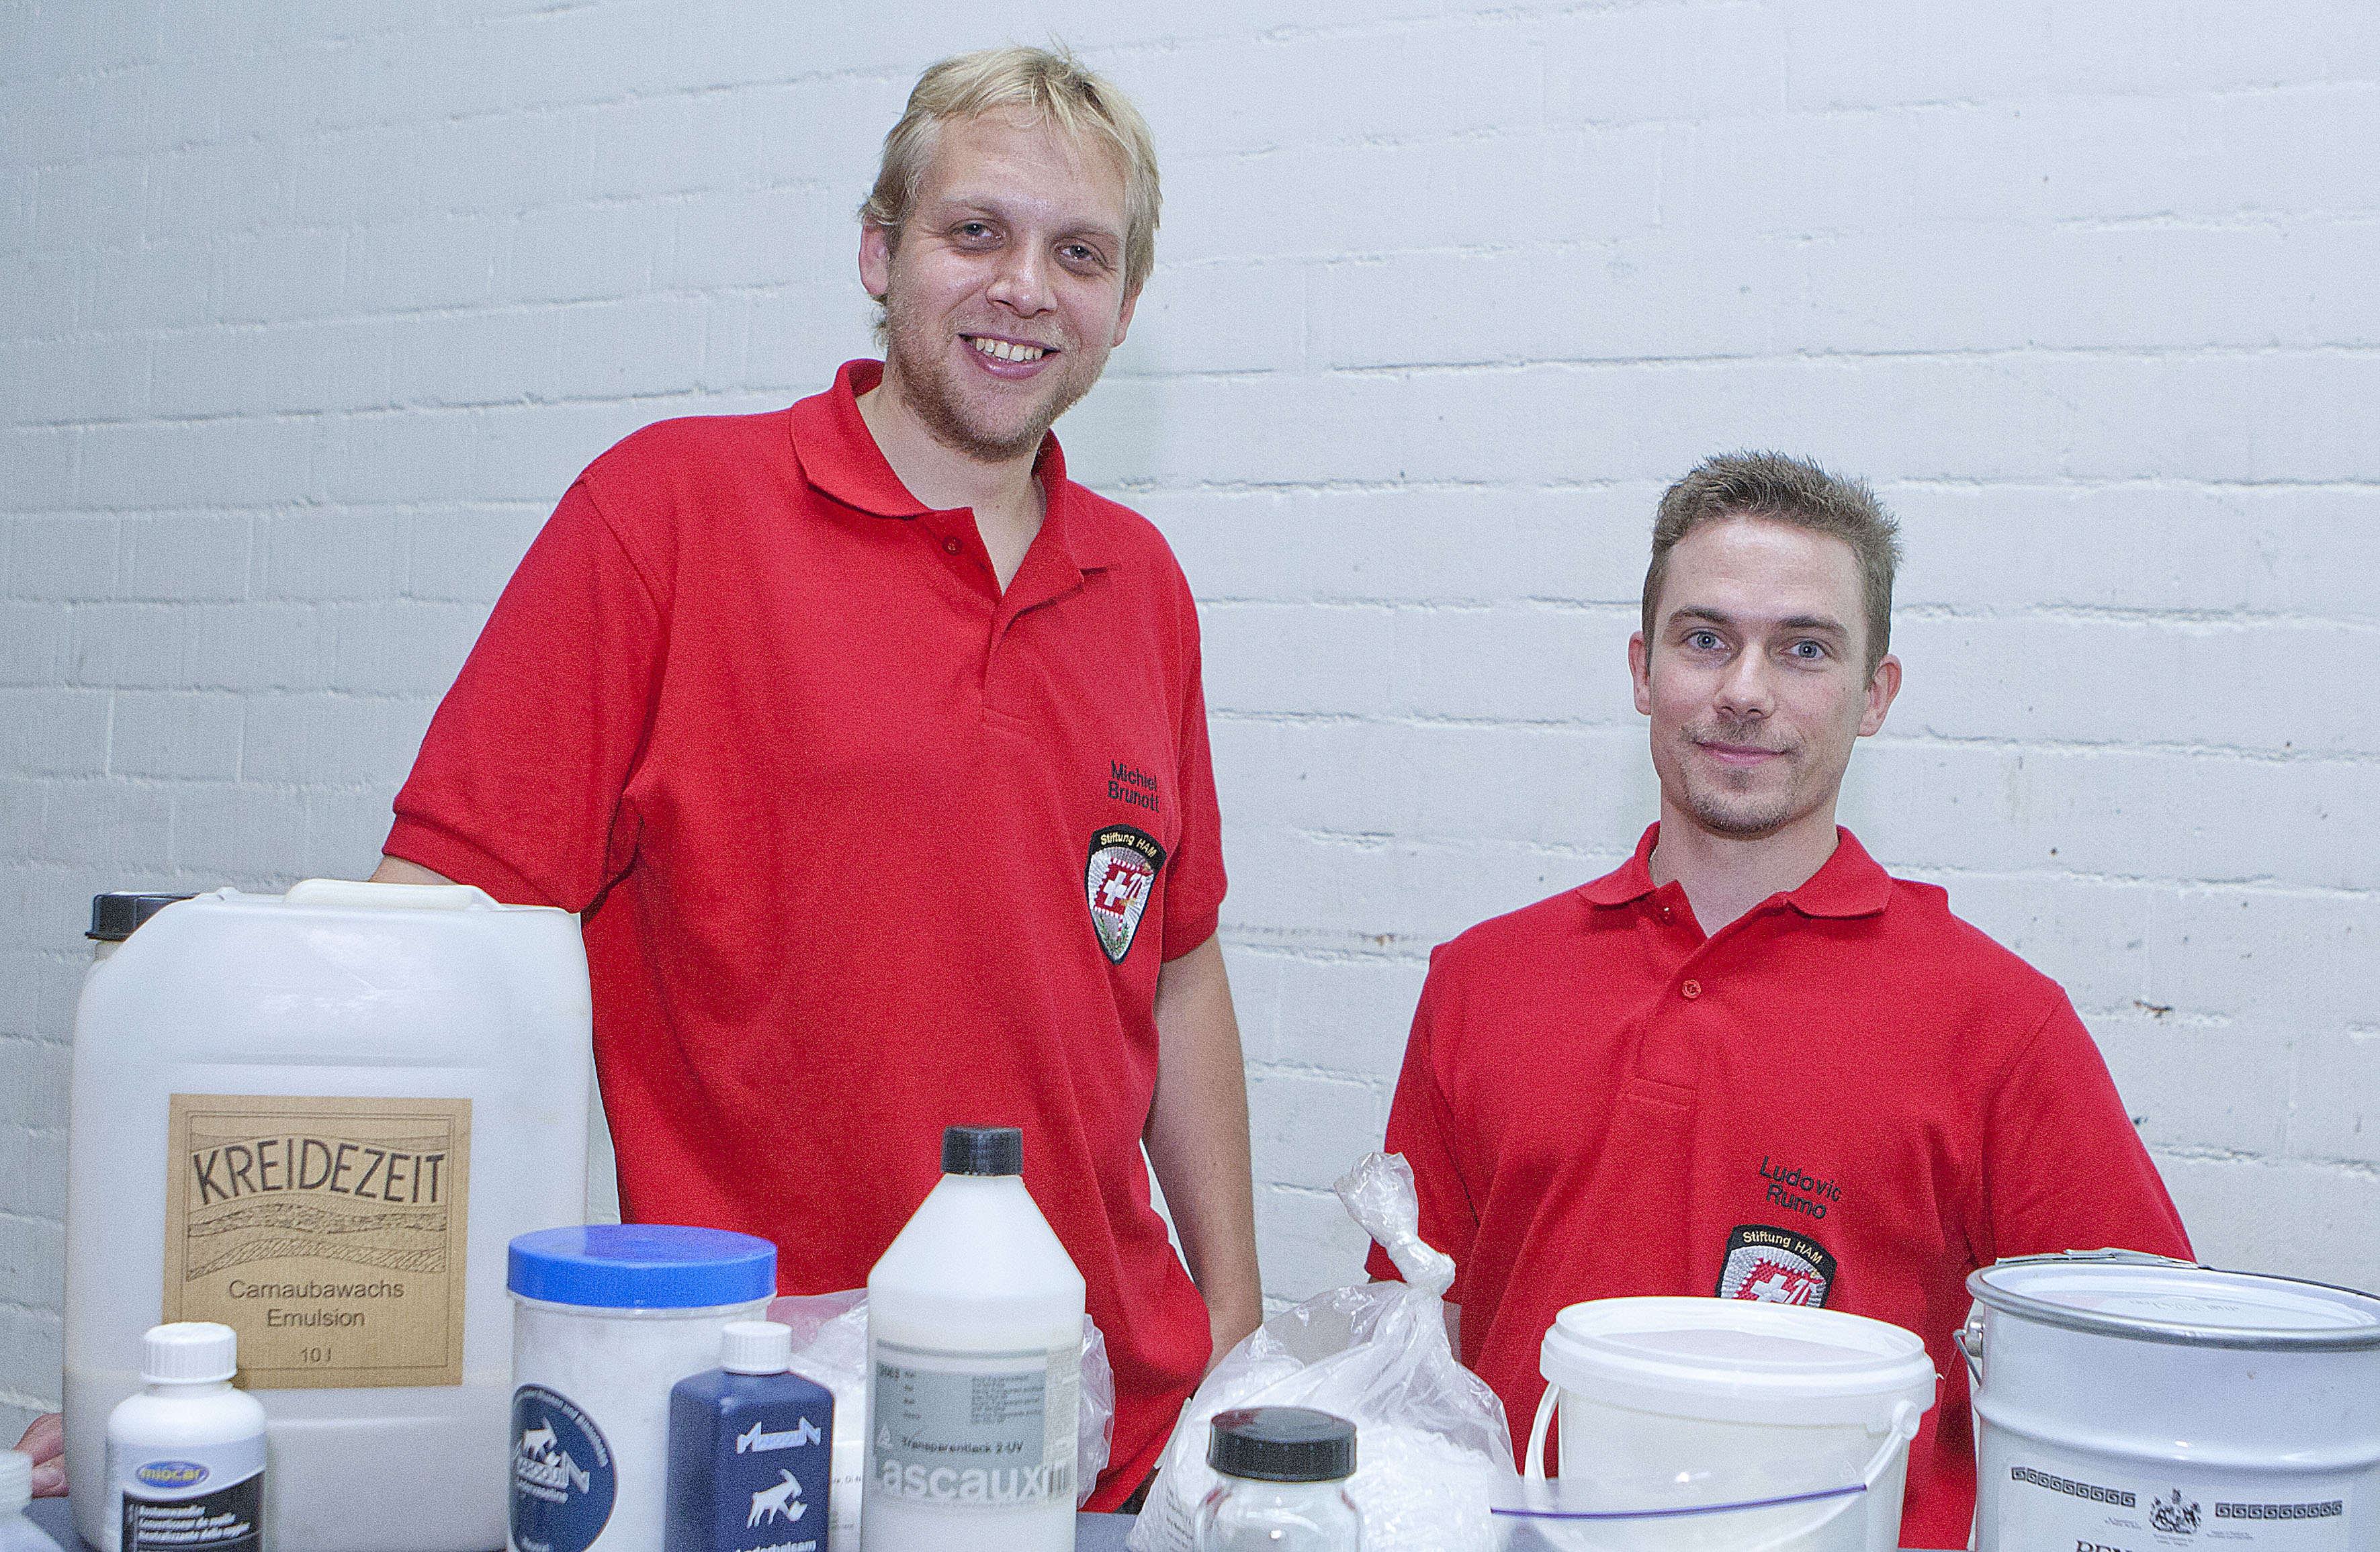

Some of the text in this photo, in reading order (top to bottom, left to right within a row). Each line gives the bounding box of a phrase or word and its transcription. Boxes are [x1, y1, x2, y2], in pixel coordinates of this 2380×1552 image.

[1110, 760, 1157, 792] Michiel
[1108, 780, 1159, 813] Brunott
[1100, 831, 1157, 858] Stiftung HAM
[193, 1138, 445, 1204] KREIDEZEIT
[1759, 1156, 1842, 1202] Ludovic
[1765, 1183, 1826, 1220] Rumo
[1743, 1231, 1823, 1264] Stiftung HAM
[228, 1279, 404, 1300] Carnaubawachs
[267, 1308, 365, 1328] Emulsion
[300, 1346, 322, 1363] 10
